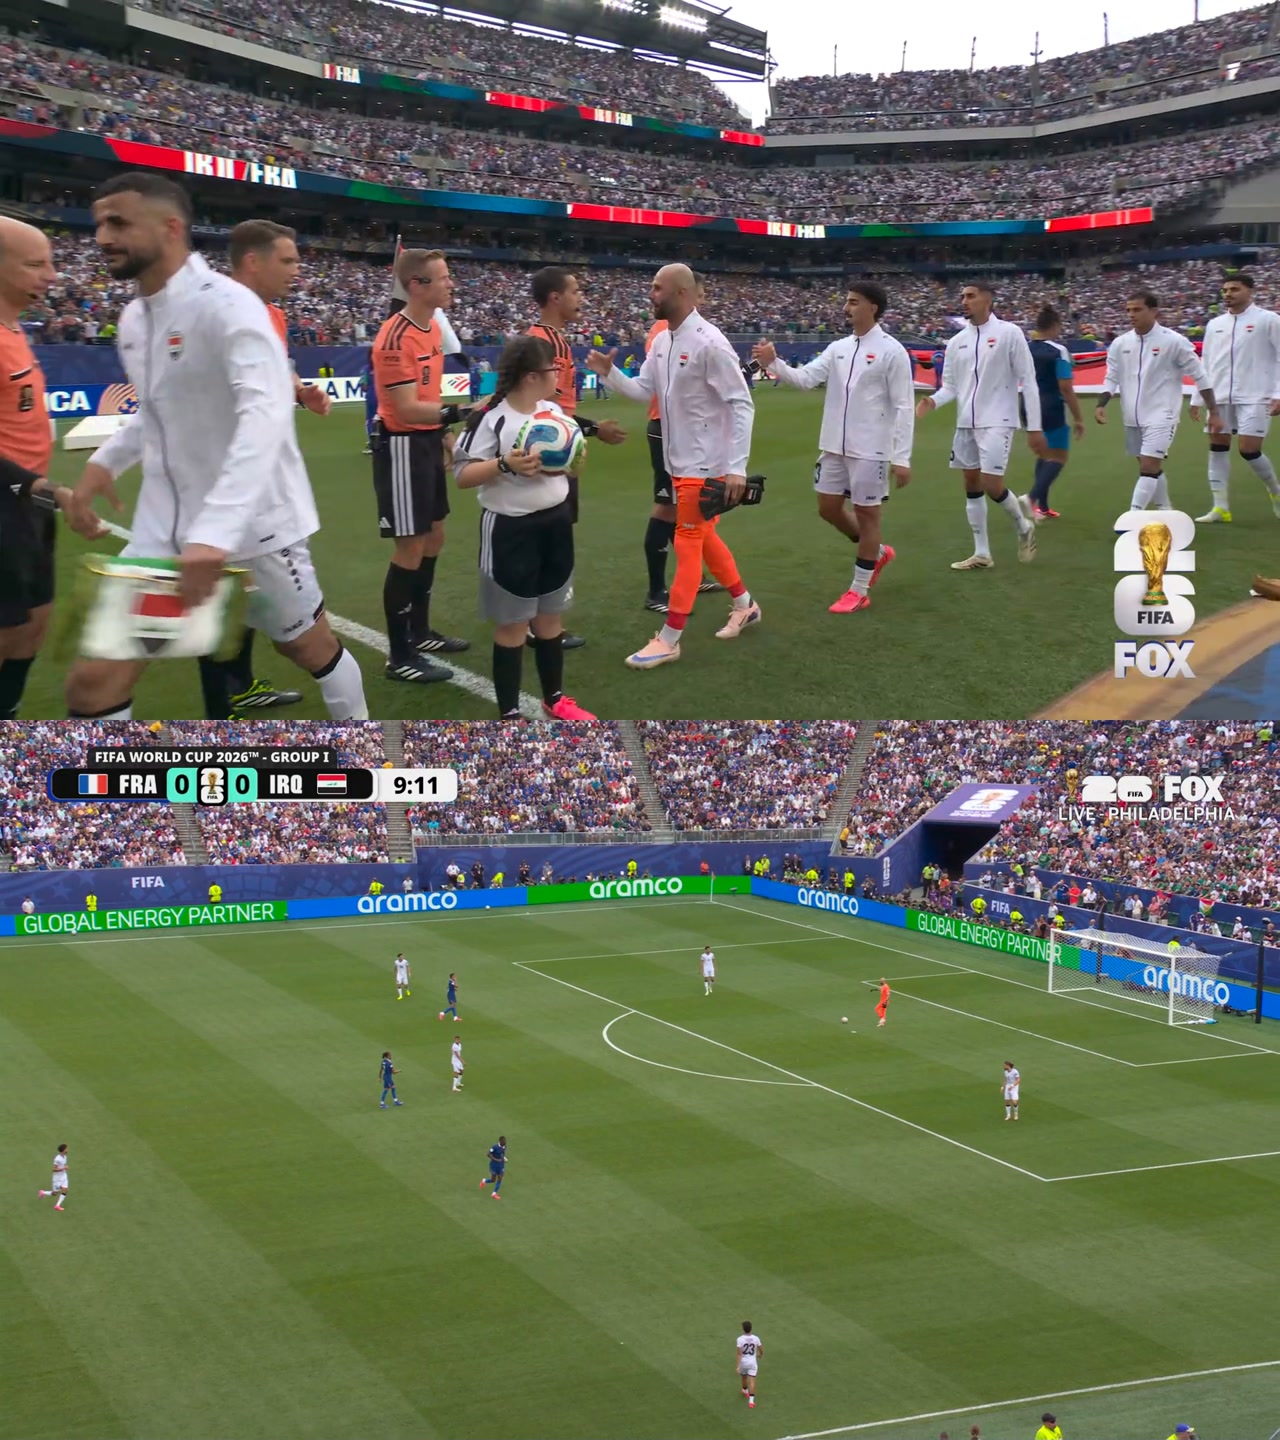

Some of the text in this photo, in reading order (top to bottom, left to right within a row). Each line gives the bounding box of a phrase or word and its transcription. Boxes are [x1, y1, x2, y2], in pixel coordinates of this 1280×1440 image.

[131, 876, 165, 888] FIFA
[589, 877, 683, 899] aramco
[357, 891, 458, 914] aramco
[798, 888, 859, 916] aramco
[991, 900, 1010, 915] FIFA
[24, 903, 274, 934] GLOBAL ENERGY PARTNER
[918, 913, 1062, 965] GLOBAL ENERGY PARTNER
[1143, 965, 1230, 1005] aramco
[742, 1343, 756, 1356] 23
